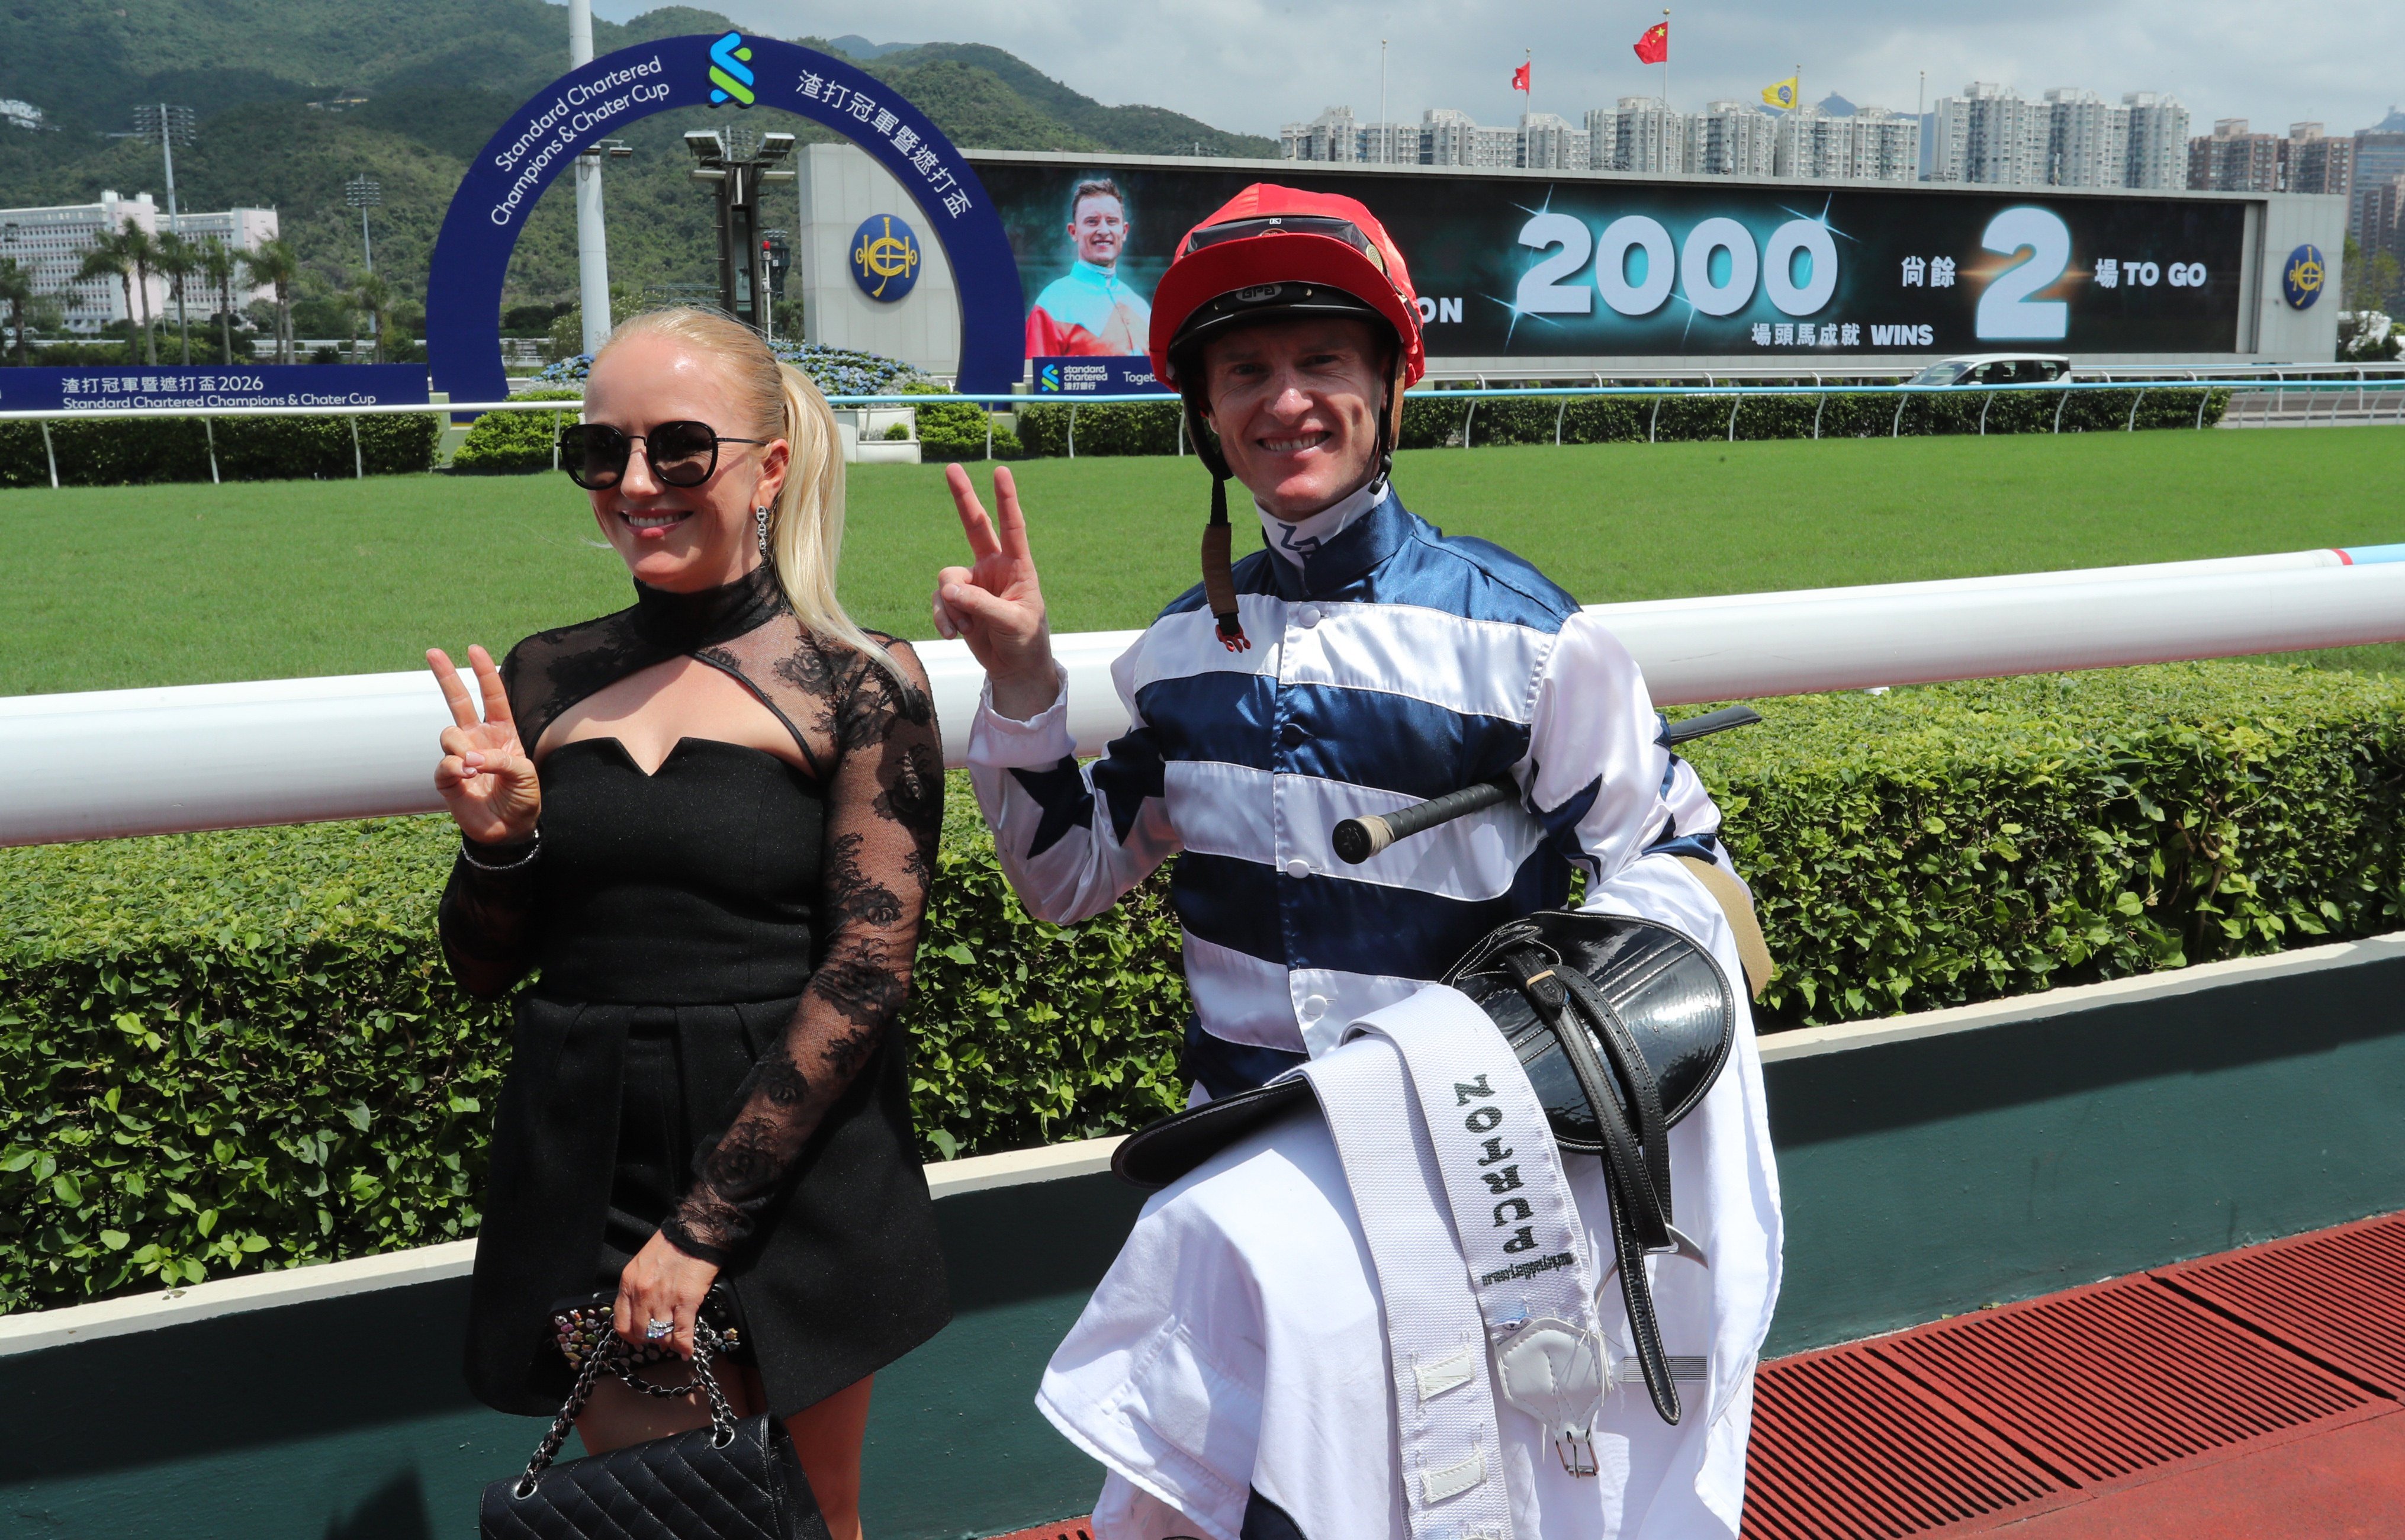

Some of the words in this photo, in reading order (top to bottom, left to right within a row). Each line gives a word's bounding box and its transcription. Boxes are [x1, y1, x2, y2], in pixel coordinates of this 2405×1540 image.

[495, 97, 570, 172] Standard
[567, 54, 663, 106] Chartered
[795, 69, 972, 219] 渣打冠軍暨遮打盃
[490, 139, 564, 226] Champions
[558, 125, 577, 143] &
[571, 94, 630, 132] Chater
[631, 83, 670, 101] Cup
[1516, 213, 1838, 316] 2000
[1901, 256, 1956, 288] 尚餘
[1976, 207, 2069, 338] 2
[2094, 258, 2118, 289] 場
[2123, 262, 2159, 287] TO
[2167, 262, 2207, 287] GO
[1751, 323, 1860, 346] 場頭馬成就
[1870, 324, 1934, 346] WINS
[218, 376, 264, 392] 2026
[1063, 365, 1105, 373] standard
[1063, 372, 1108, 381] chartered
[1122, 371, 1157, 385] Toget
[63, 396, 131, 410] Standard
[133, 395, 205, 409] Chartered
[207, 394, 285, 408] Champions
[287, 394, 299, 406] &
[300, 392, 346, 406] Chater
[349, 392, 377, 406] Cup
[1454, 1073, 1539, 1255] PURTON
